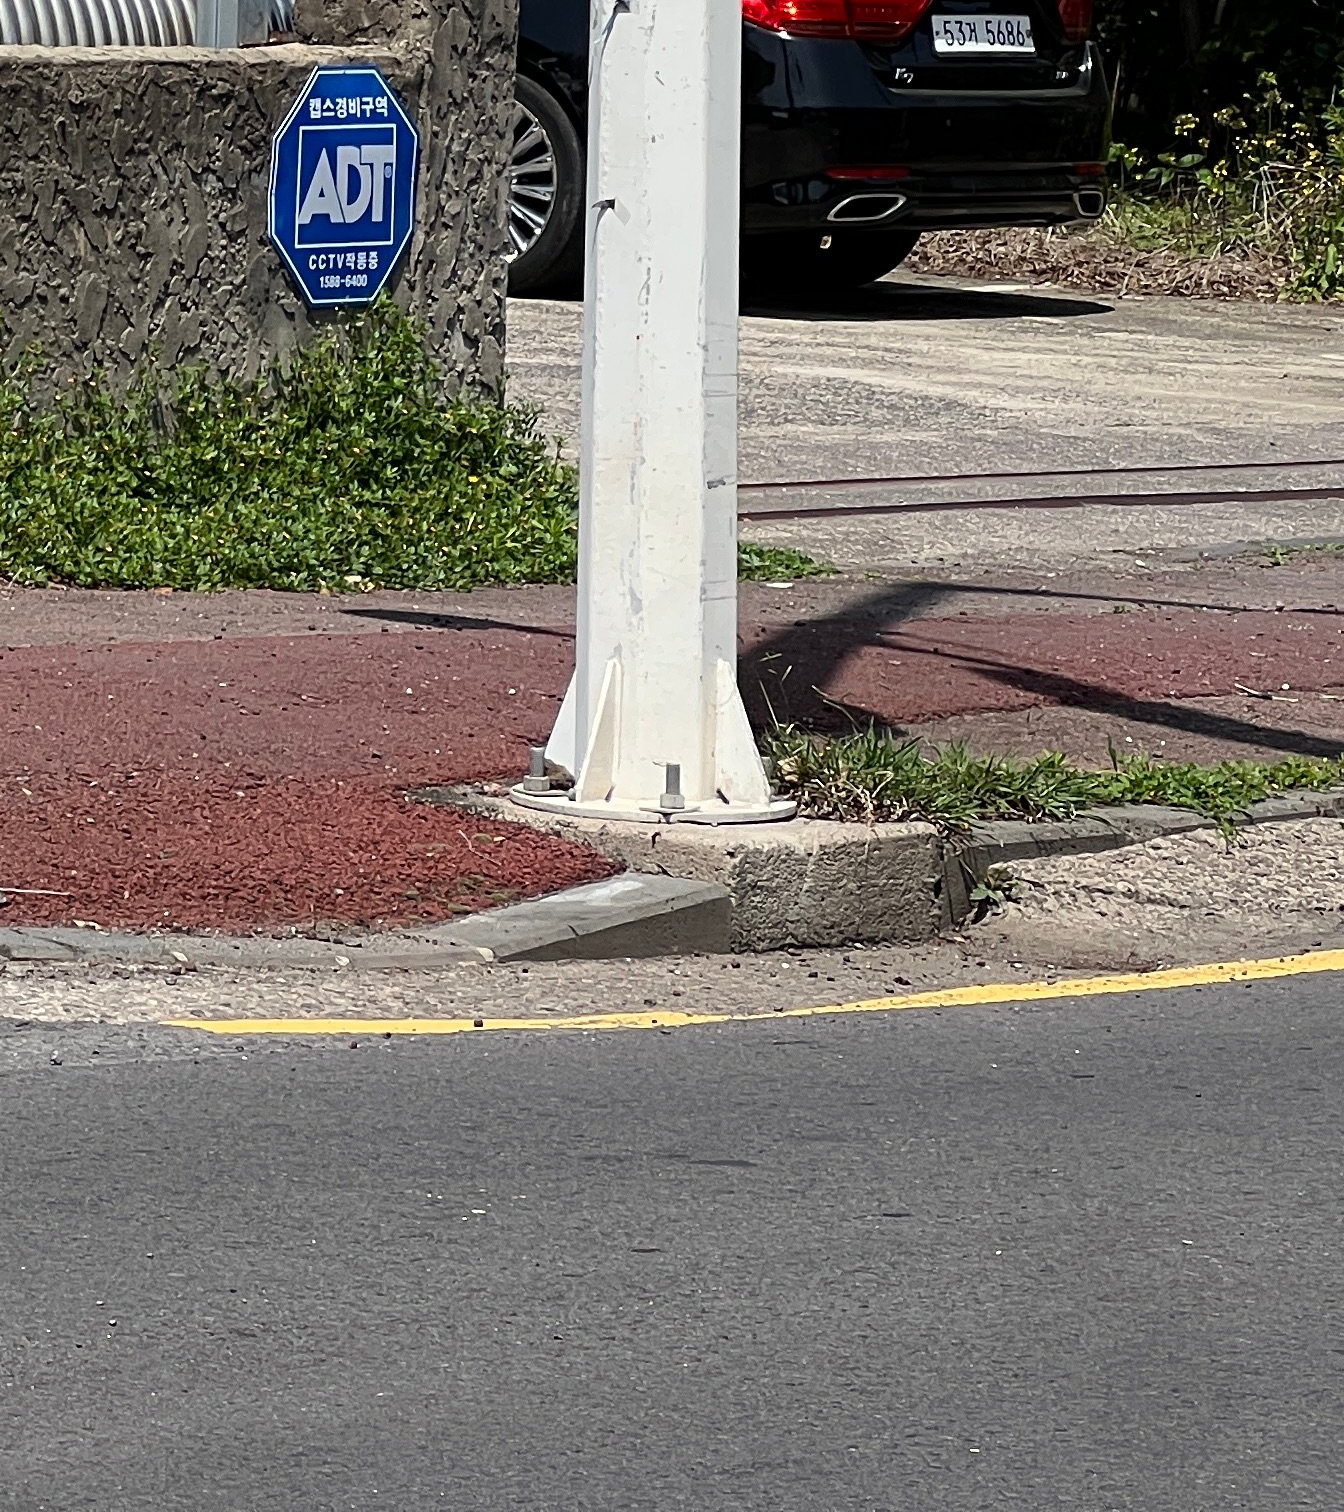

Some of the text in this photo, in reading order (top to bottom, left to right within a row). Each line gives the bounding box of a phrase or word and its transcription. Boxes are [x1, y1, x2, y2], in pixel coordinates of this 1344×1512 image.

[985, 20, 1026, 46] 5686
[309, 96, 388, 119] 캡스경비구역
[298, 144, 394, 225] ADT
[308, 251, 378, 270] CCTV작동중
